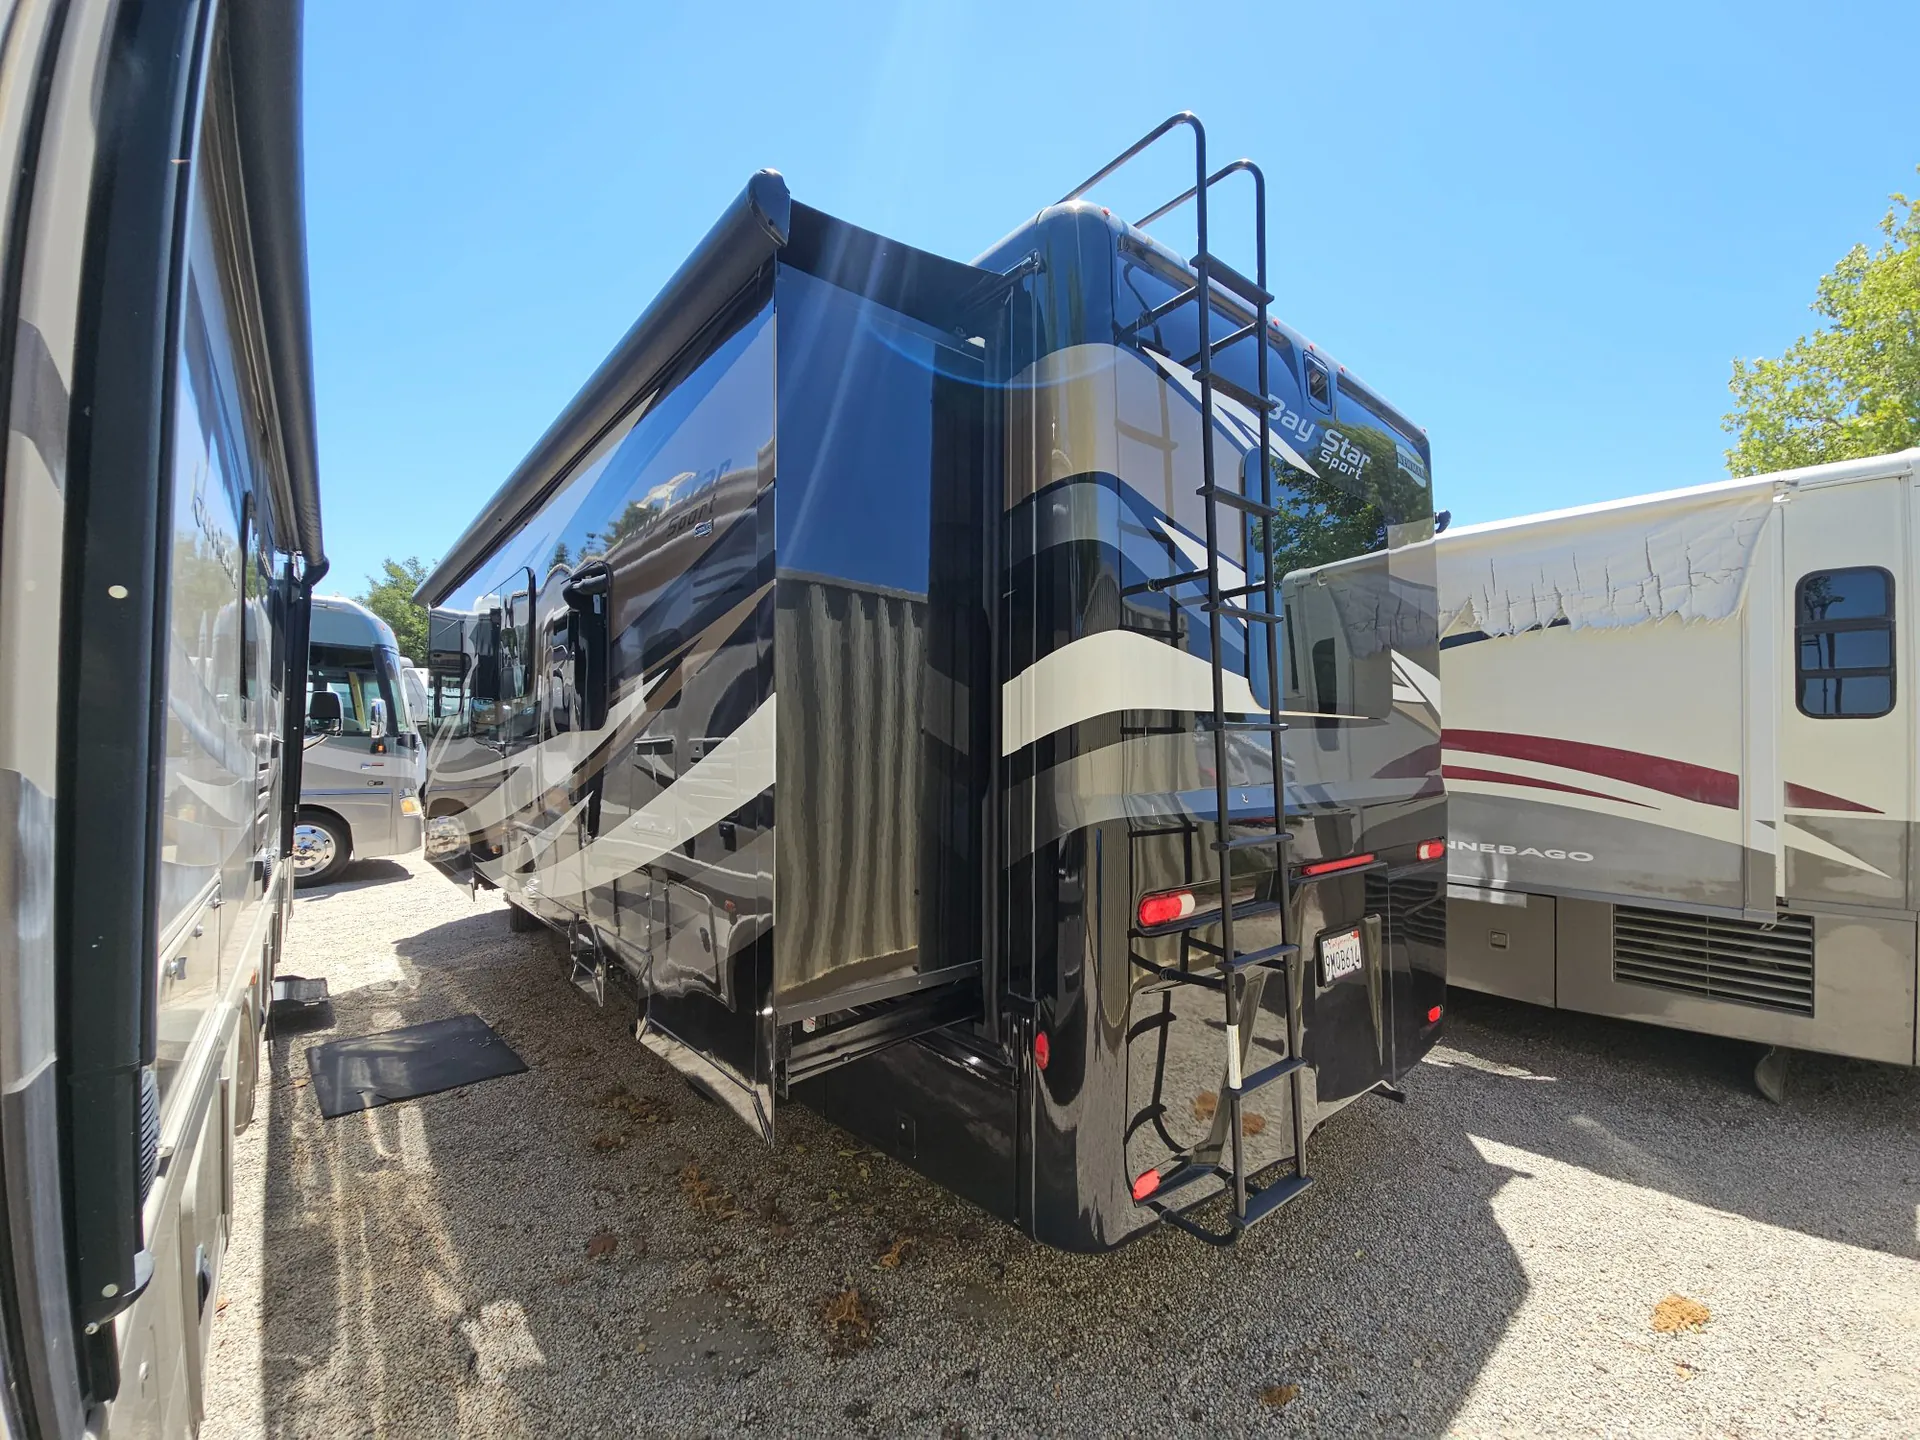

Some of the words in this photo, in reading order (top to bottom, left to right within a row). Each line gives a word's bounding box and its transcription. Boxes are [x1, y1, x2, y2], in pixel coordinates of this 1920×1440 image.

[1267, 393, 1316, 442] Bay
[1321, 428, 1372, 467] Star
[1318, 450, 1363, 480] Sport
